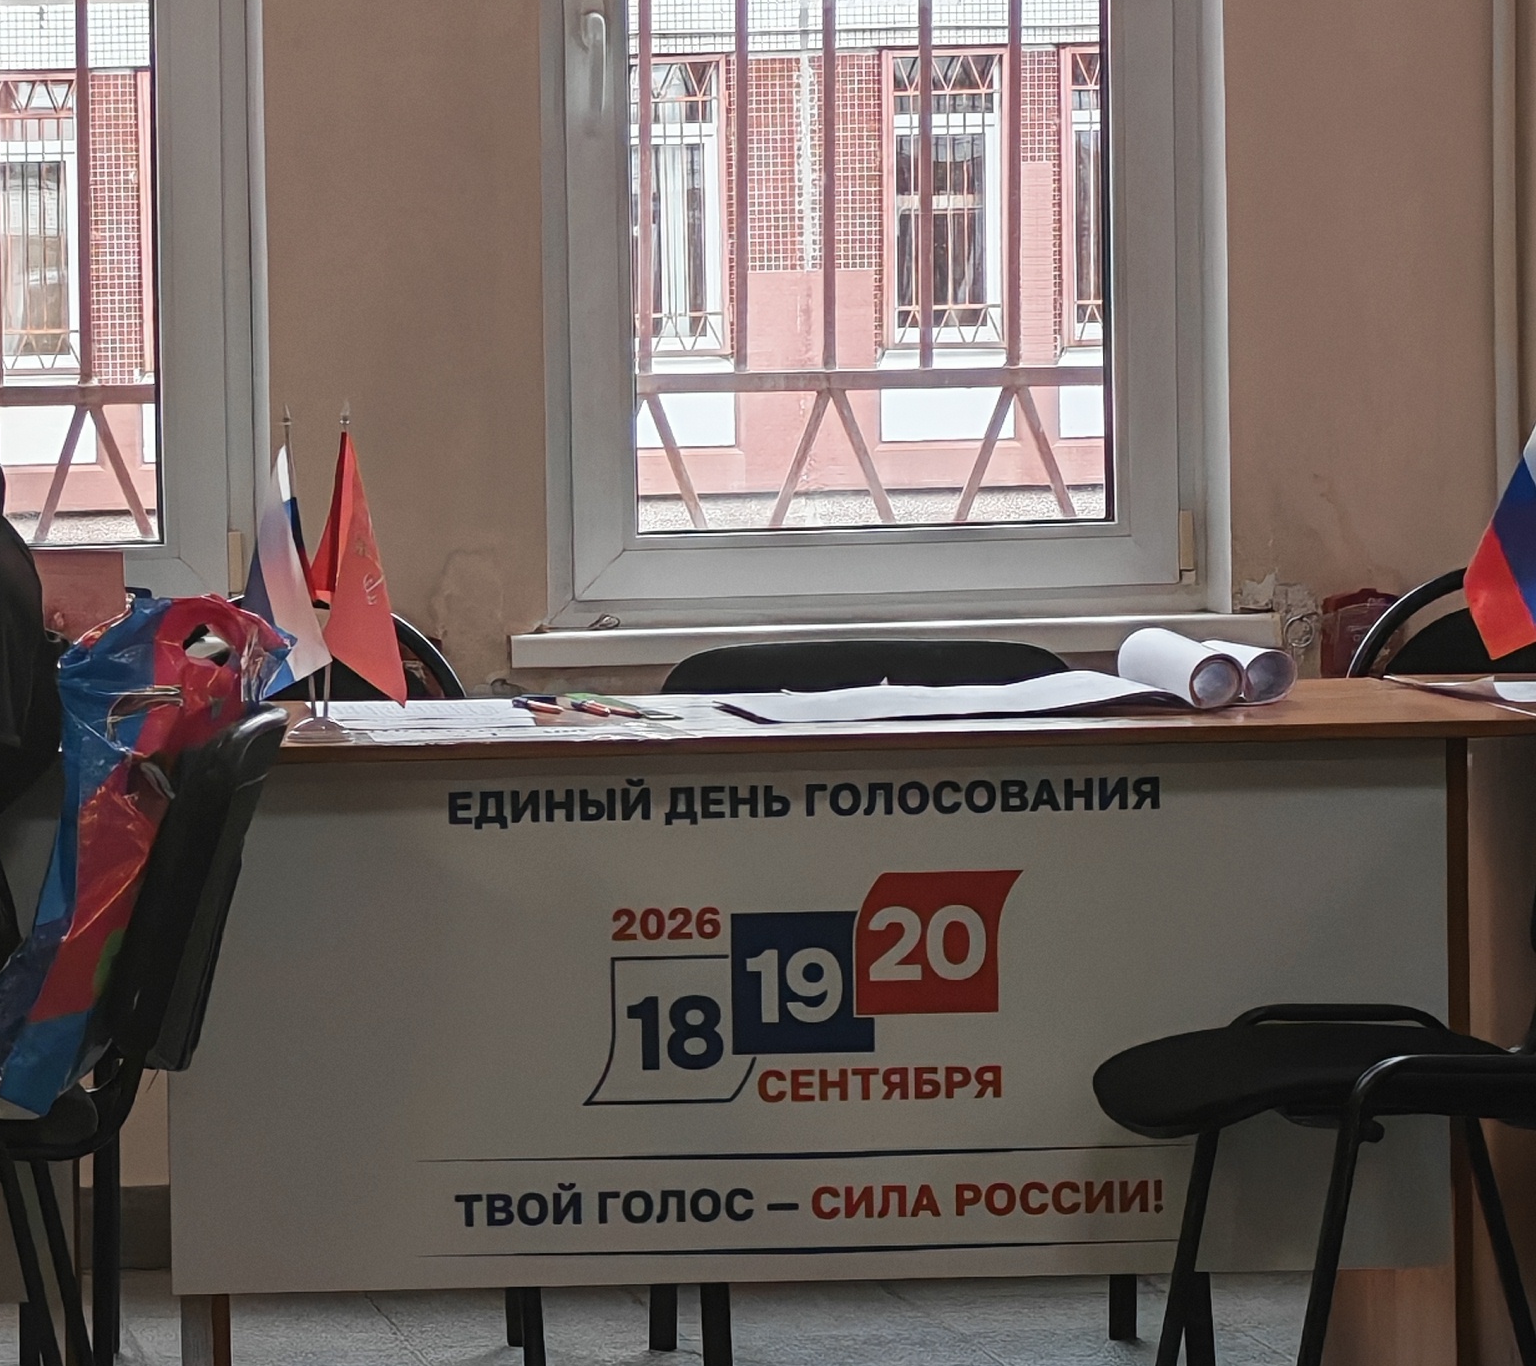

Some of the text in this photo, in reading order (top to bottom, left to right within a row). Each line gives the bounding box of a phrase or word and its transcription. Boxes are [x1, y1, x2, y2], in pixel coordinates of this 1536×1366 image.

[448, 777, 1161, 829] ЕДИНЫЙ ДЕНЬ ГОЛОСОВАНИЯ
[611, 907, 721, 941] 2026
[626, 904, 986, 1071] 18 19 20
[758, 1065, 1002, 1103] СЕНТЯБРЯ
[455, 1182, 582, 1227] ТВОЙ
[598, 1188, 754, 1224] ГОЛОС
[811, 1184, 941, 1220] СИЛА
[956, 1179, 1163, 1216] РОССИИ!
